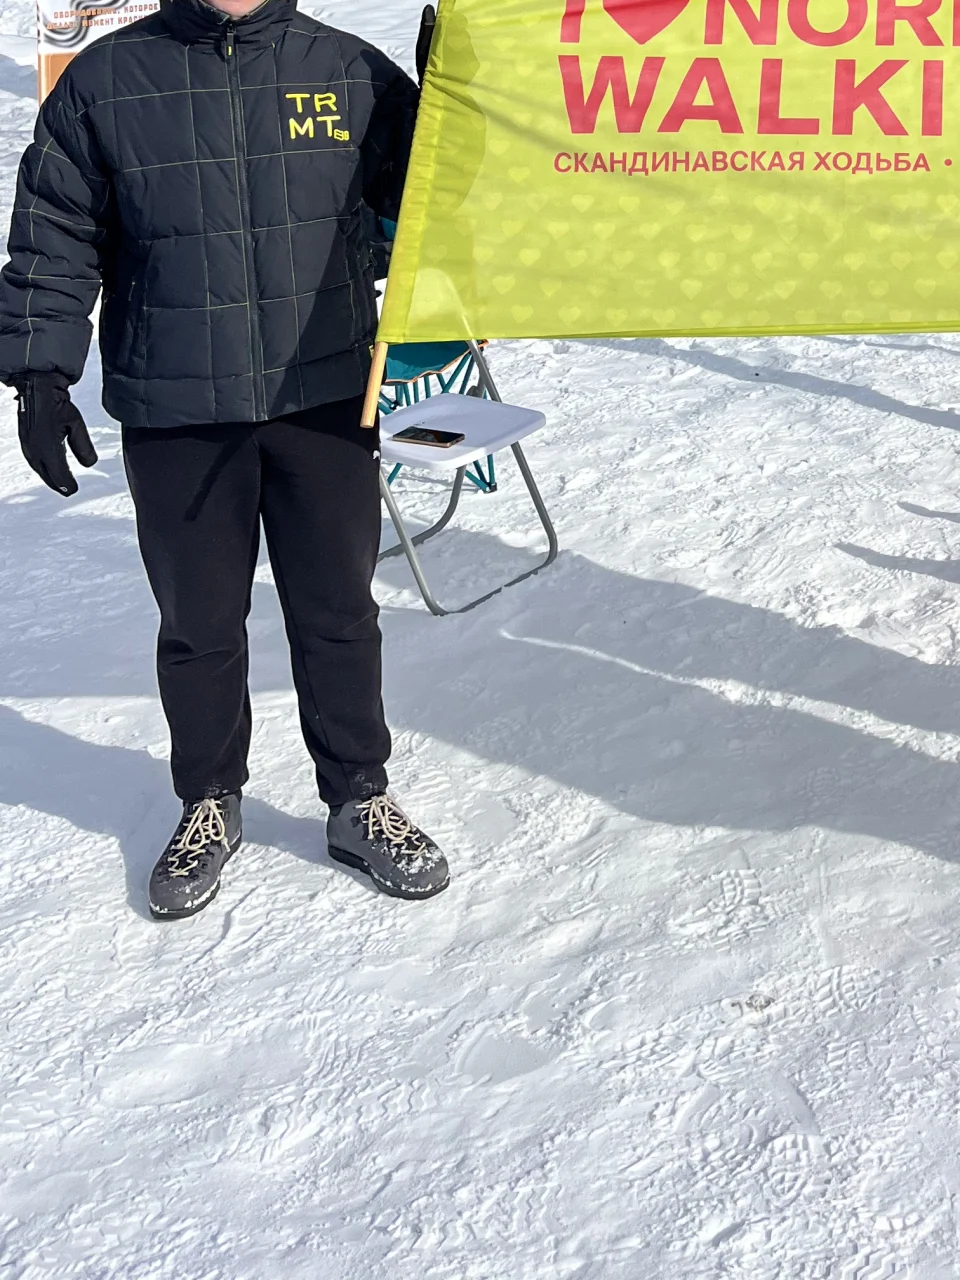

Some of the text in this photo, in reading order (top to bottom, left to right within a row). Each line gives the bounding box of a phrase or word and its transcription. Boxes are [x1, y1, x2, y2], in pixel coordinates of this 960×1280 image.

[124, 3, 158, 13] КОТОРОЕ
[82, 17, 114, 27] МОМЕНТ
[118, 15, 147, 25] КРАС
[285, 92, 338, 113] TR
[554, 150, 805, 176] СКАНДИНАВСКАЯ
[813, 152, 930, 175] ХОДЬБА
